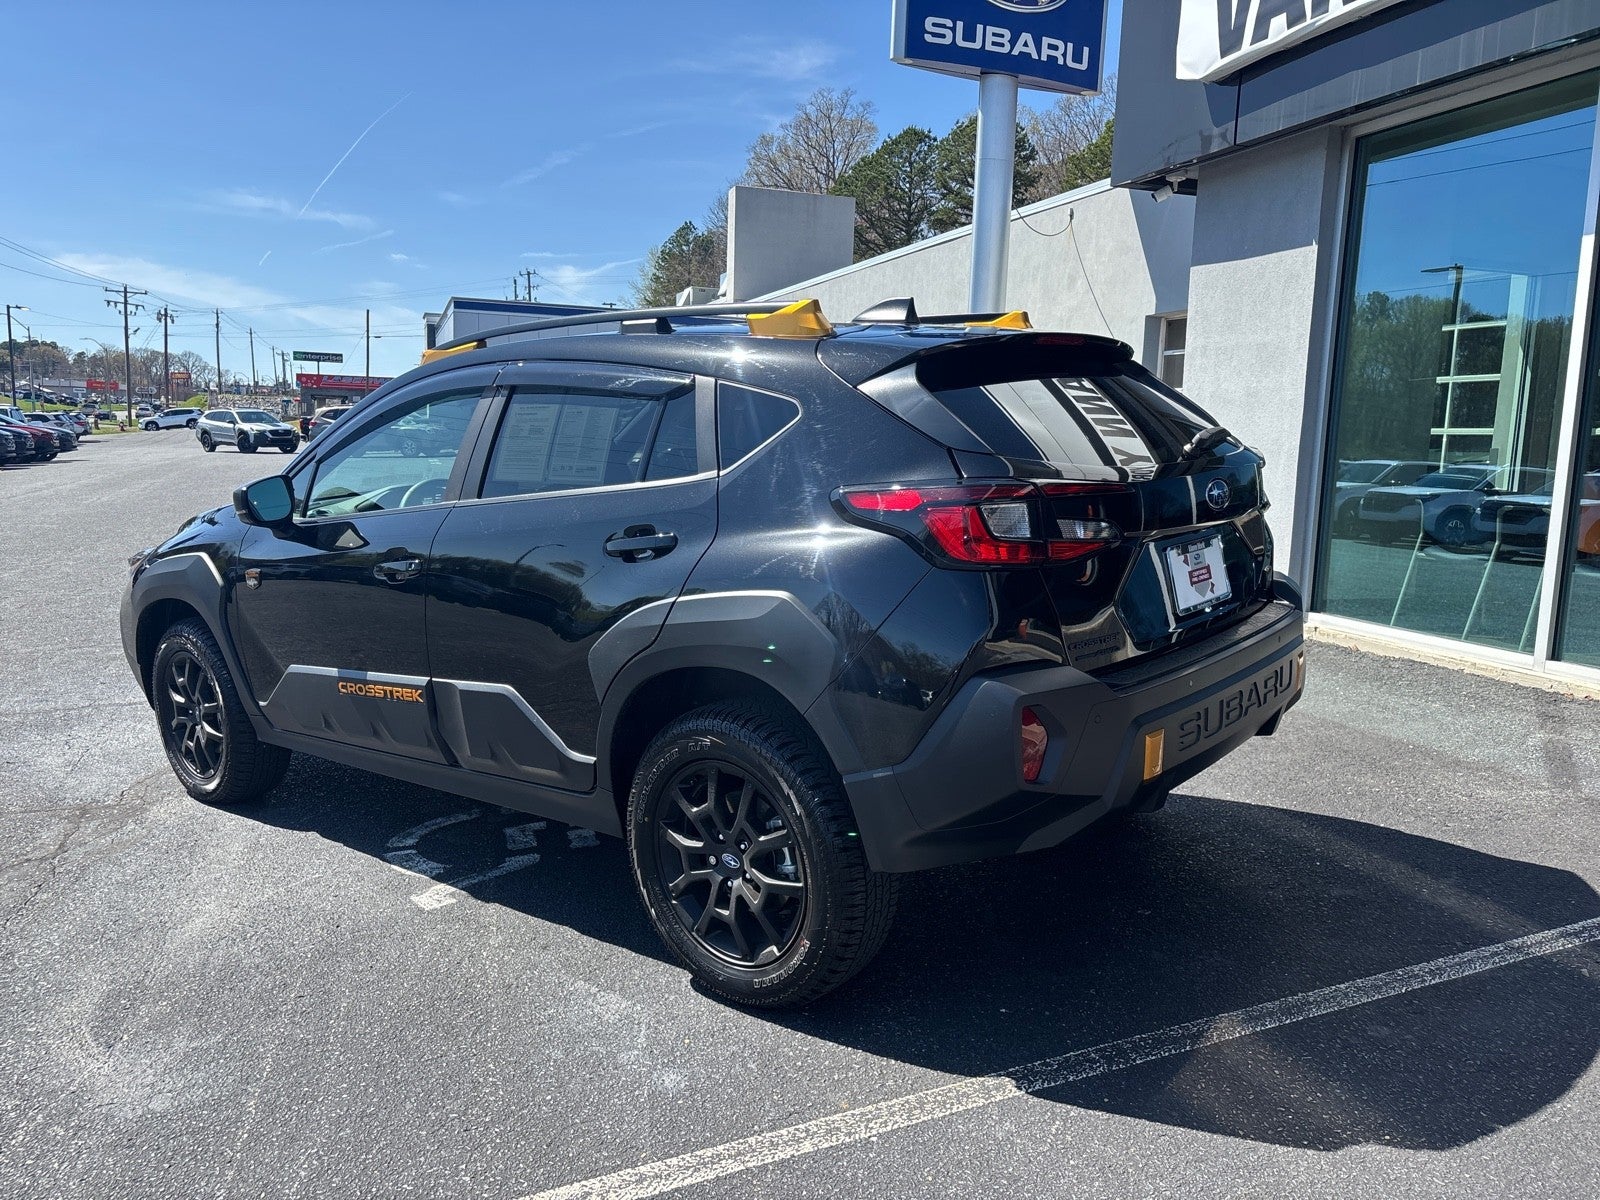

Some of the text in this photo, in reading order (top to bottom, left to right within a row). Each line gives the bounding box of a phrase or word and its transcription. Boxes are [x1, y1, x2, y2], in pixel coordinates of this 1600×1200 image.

[924, 16, 1089, 71] SUBARU
[295, 353, 342, 361] enterprise
[338, 681, 424, 703] CROSSTREK
[1178, 659, 1293, 752] SUBARU
[753, 938, 811, 989] YOKOHAMA
